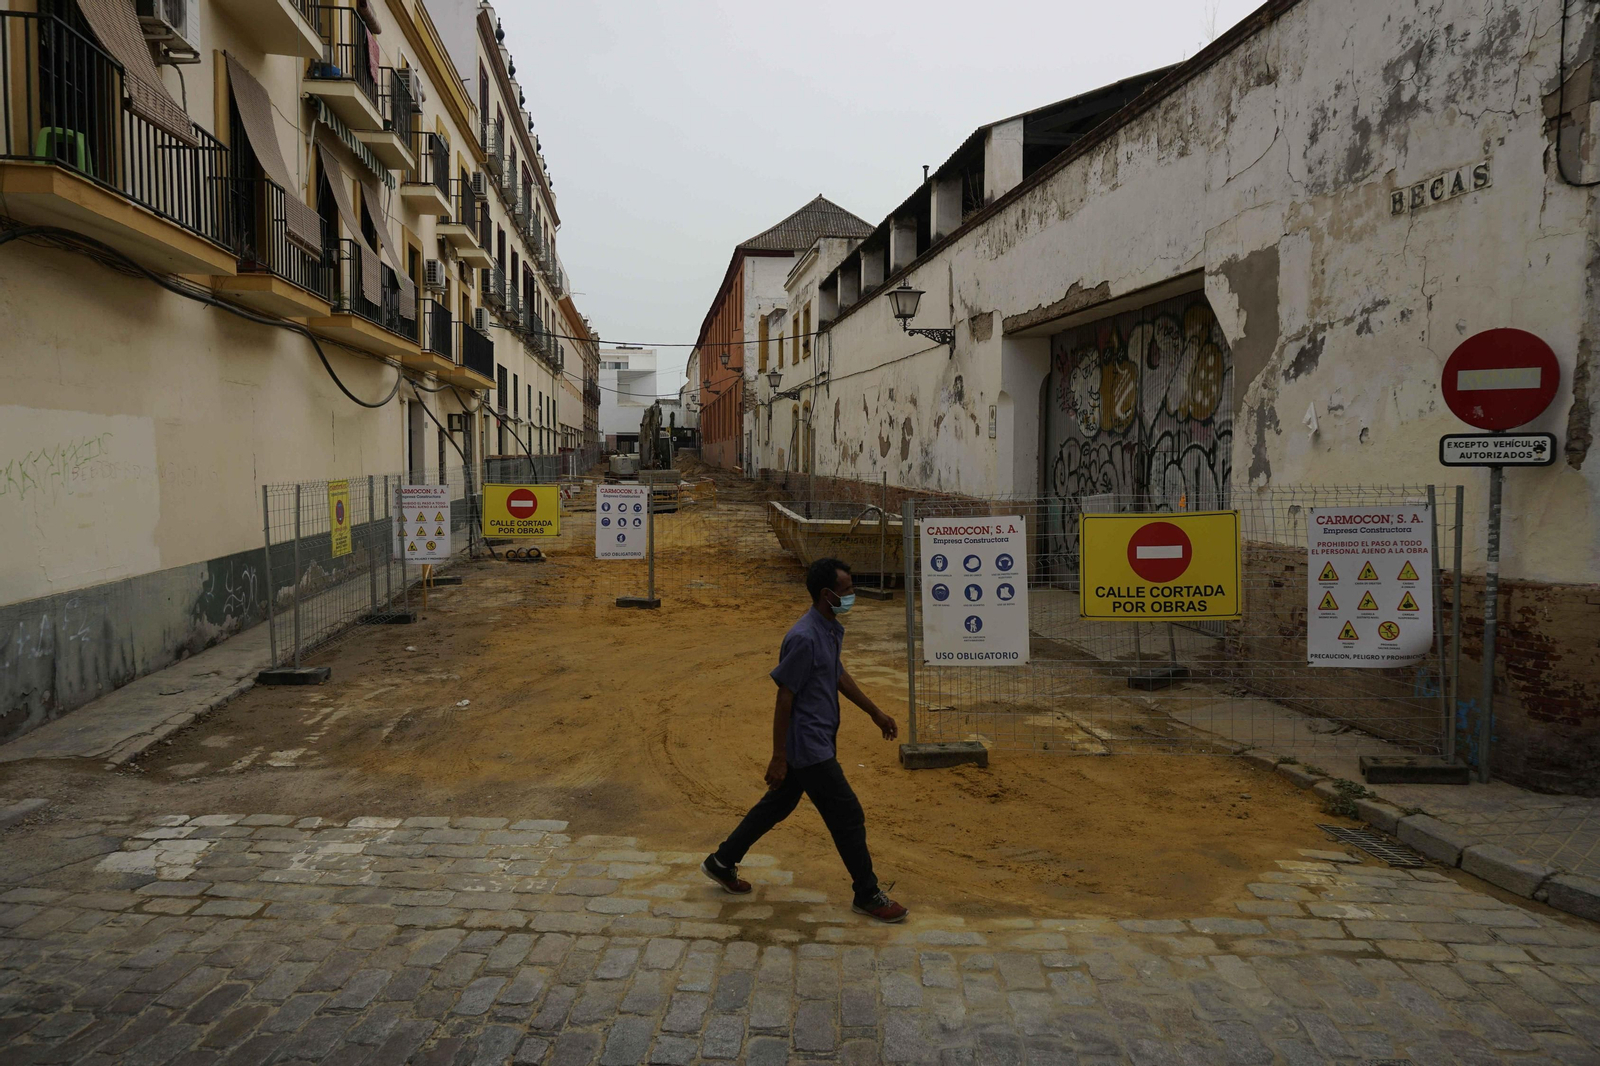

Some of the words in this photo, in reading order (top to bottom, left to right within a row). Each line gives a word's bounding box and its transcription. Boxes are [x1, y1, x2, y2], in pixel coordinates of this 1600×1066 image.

[1391, 162, 1490, 216] BECAS
[1447, 441, 1489, 449] EXCEPTO
[1459, 451, 1533, 460] AUTORIZADOS
[1316, 514, 1393, 526] CARMOCON,
[1397, 514, 1406, 523] S.
[1410, 514, 1424, 523] A.
[927, 526, 993, 536] CARMOCON,
[996, 526, 1004, 534] S.
[1008, 525, 1019, 534] A.
[1095, 586, 1145, 598] CALLE
[1150, 585, 1225, 598] CORTADA
[1112, 601, 1146, 613] POR
[1151, 600, 1207, 612] OBRAS
